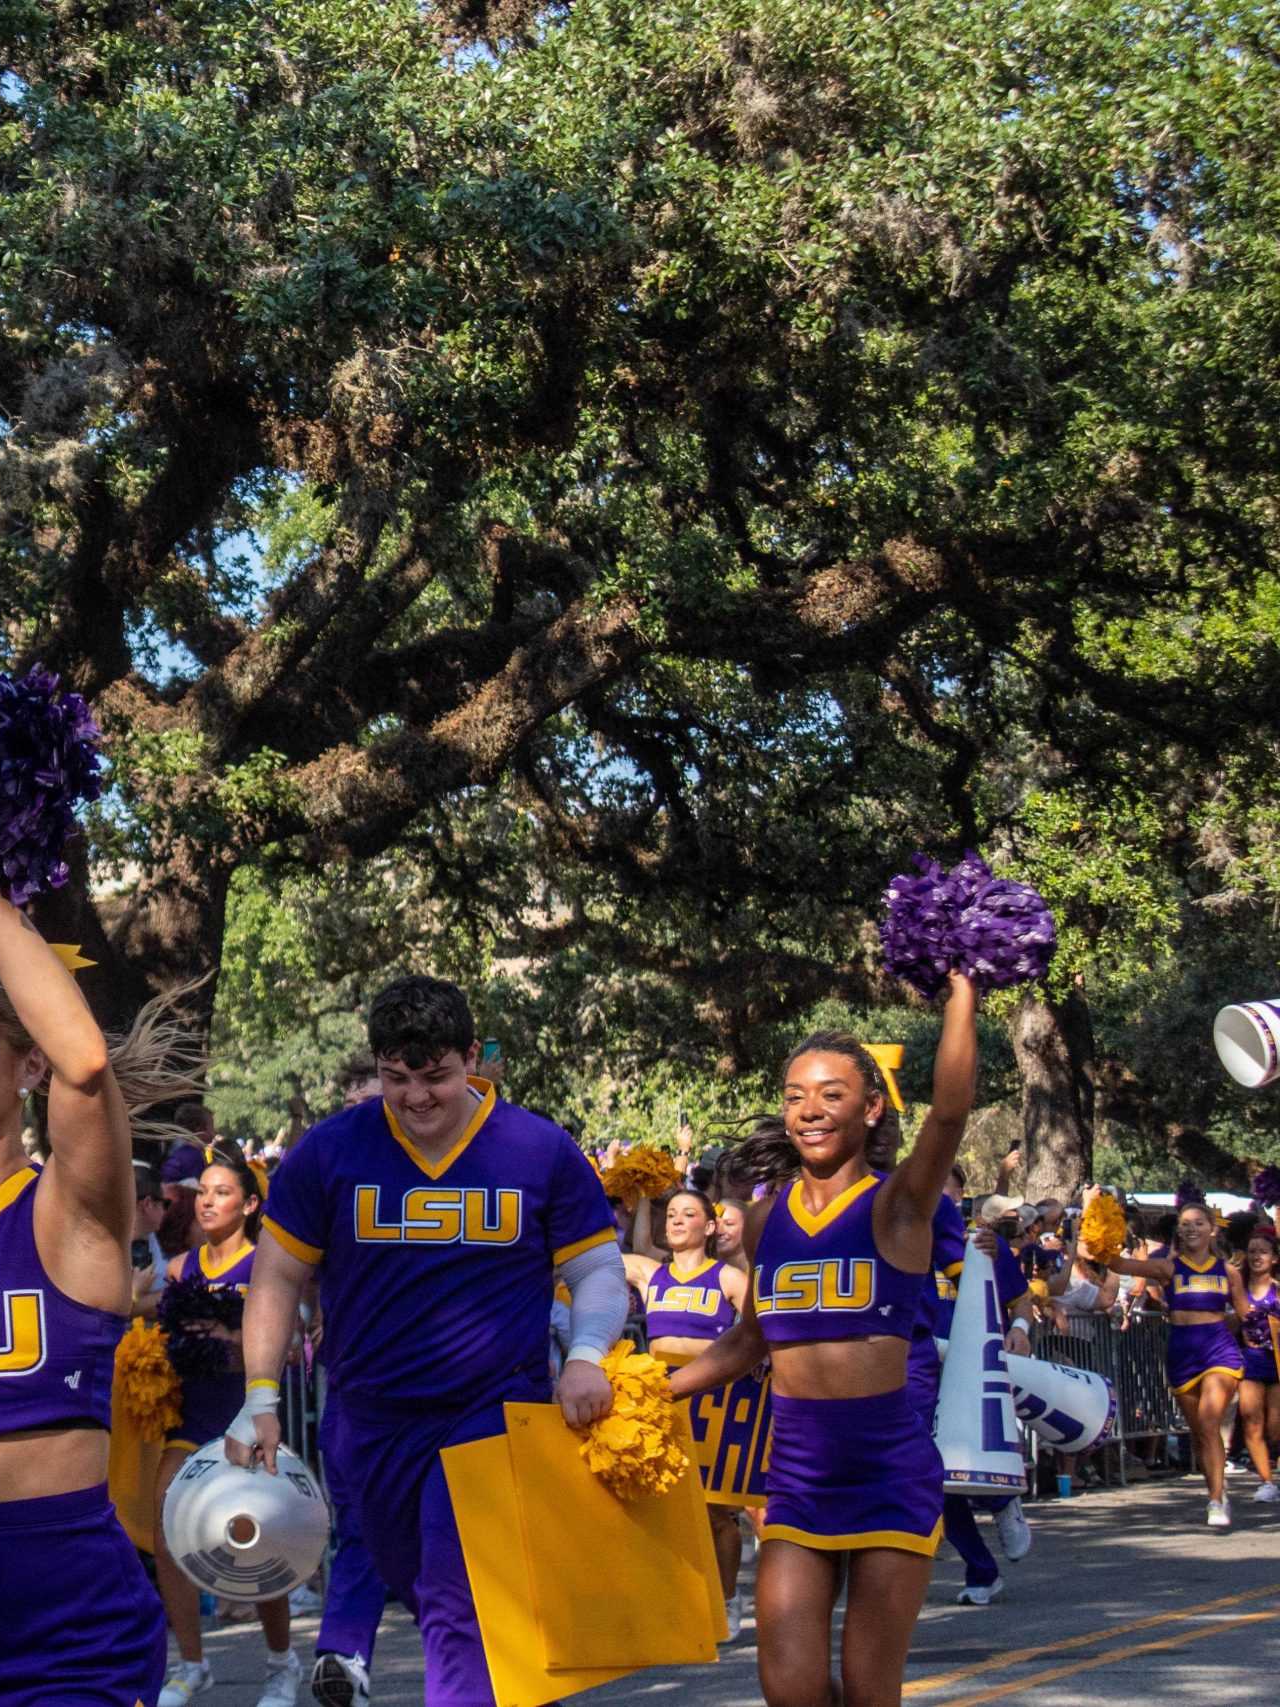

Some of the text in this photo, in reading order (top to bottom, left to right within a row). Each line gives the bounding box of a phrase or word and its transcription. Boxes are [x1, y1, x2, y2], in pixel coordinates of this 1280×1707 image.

[354, 1185, 522, 1246] LSU
[646, 1285, 721, 1317] LSU
[753, 1258, 875, 1317] LSU
[1174, 1273, 1228, 1295] LSU
